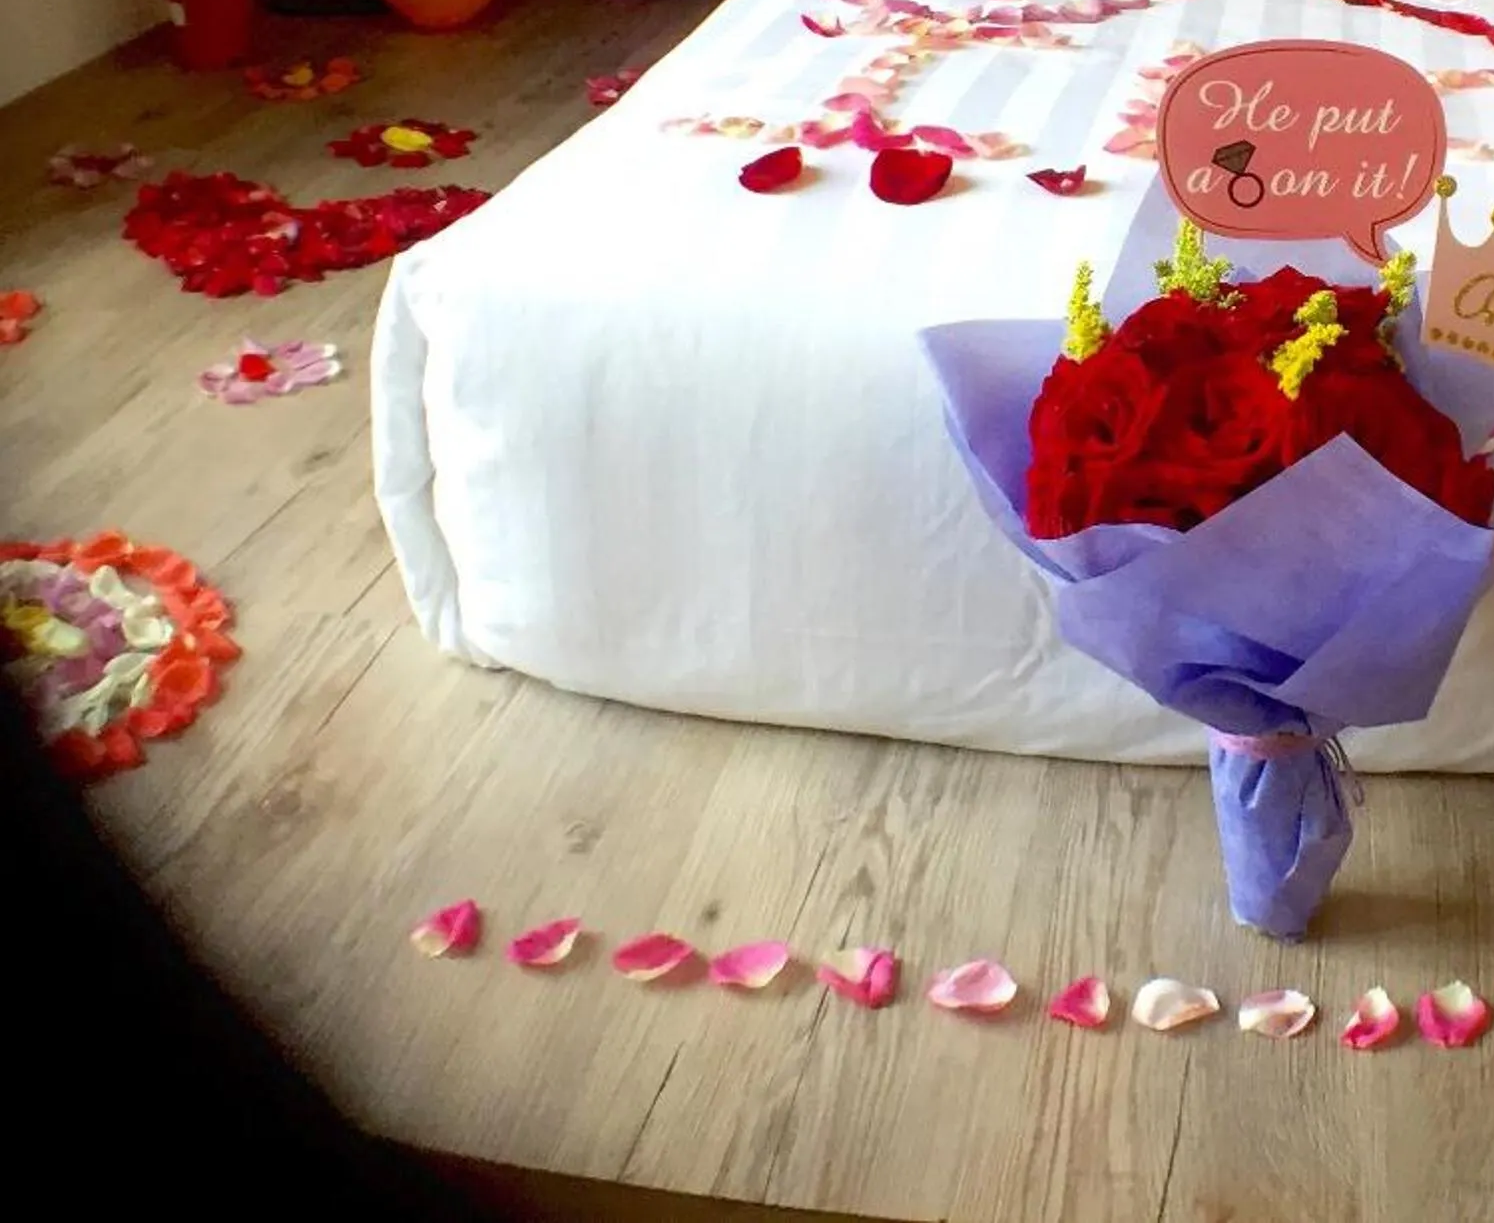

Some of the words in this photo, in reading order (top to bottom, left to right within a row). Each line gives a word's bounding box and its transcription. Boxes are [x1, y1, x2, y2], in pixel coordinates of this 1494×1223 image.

[1199, 79, 1299, 132] He
[1308, 98, 1402, 152] put
[1185, 165, 1224, 194] a
[1269, 165, 1342, 198] on
[1351, 153, 1420, 200] it!
